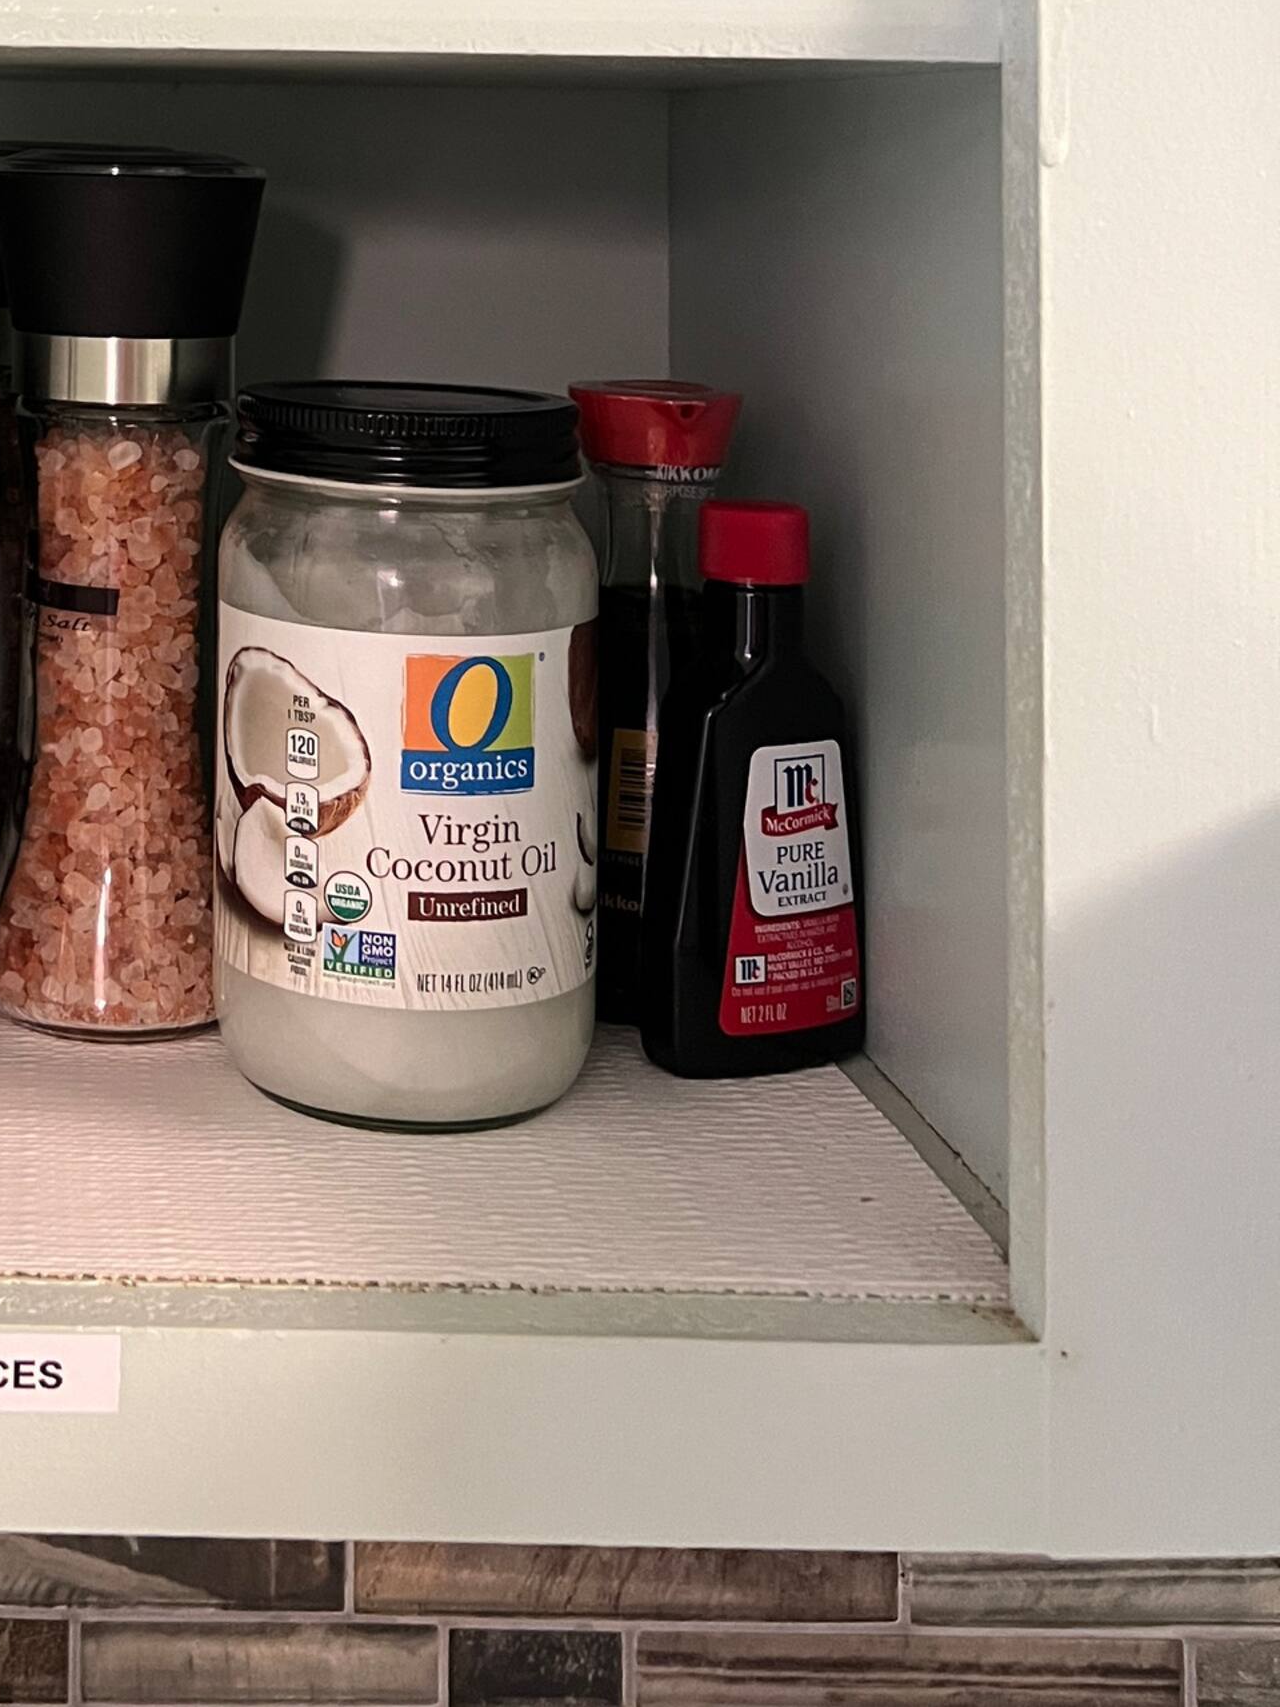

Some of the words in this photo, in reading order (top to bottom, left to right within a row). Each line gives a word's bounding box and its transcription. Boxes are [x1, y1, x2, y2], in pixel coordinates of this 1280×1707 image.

[293, 694, 310, 708] PER
[294, 709, 316, 724] TBSP
[290, 734, 316, 756] 120
[409, 754, 528, 791] organics
[765, 807, 832, 834] McCormick
[417, 813, 522, 854] Virgin
[366, 847, 512, 882] Coconut
[520, 841, 557, 877] Oil
[776, 841, 825, 865] PURE
[758, 861, 839, 894] Vanilla
[335, 883, 361, 896] USDA
[778, 891, 827, 907] EXTRACT
[331, 897, 365, 910] ORGANIC
[419, 895, 520, 918] Unrefined
[362, 934, 393, 947] NON
[362, 944, 393, 958] GMO
[325, 960, 394, 978] VERIFIED
[417, 973, 436, 992] NET
[454, 973, 465, 992] FL
[468, 971, 482, 992] OZ
[741, 1007, 756, 1023] NET
